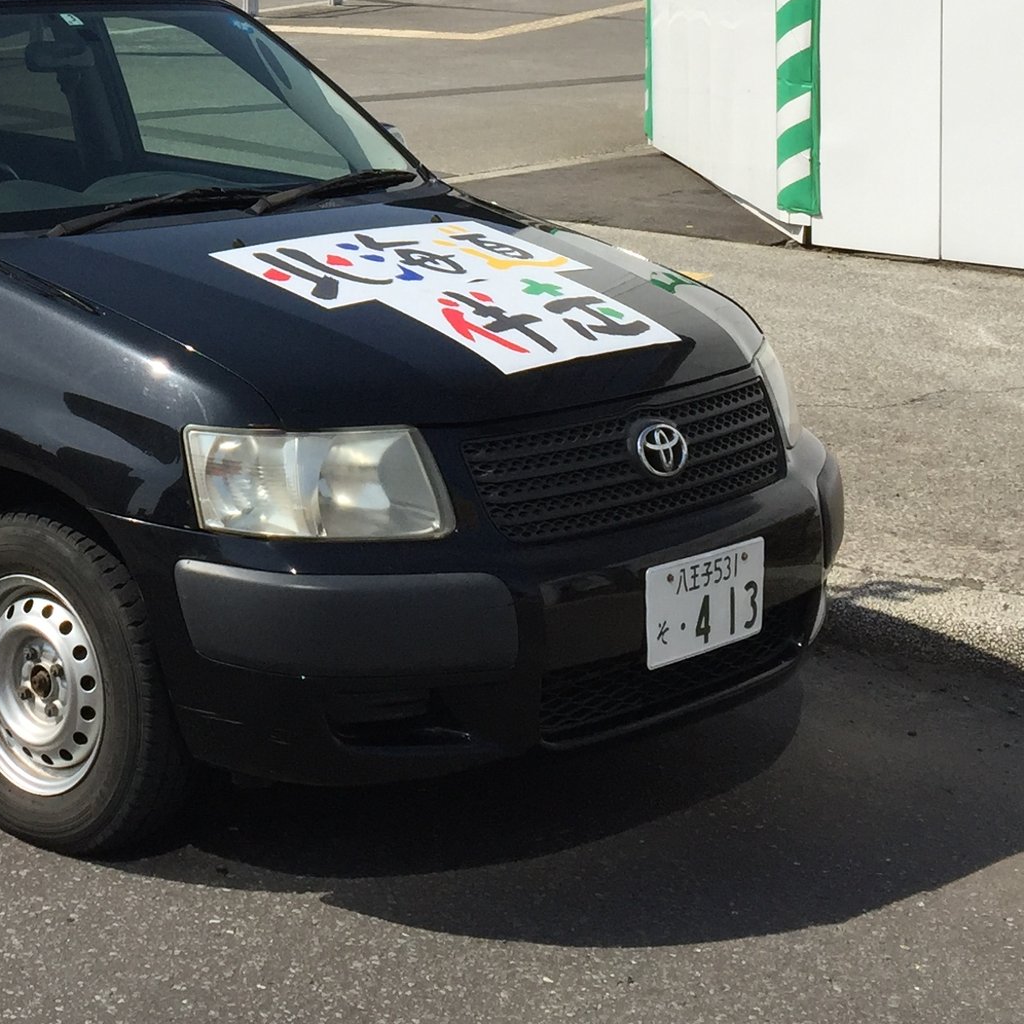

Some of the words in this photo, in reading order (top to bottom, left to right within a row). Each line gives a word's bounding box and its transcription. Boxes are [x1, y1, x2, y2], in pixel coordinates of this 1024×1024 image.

[252, 226, 569, 300] 北海道
[676, 553, 738, 595] 八王子531
